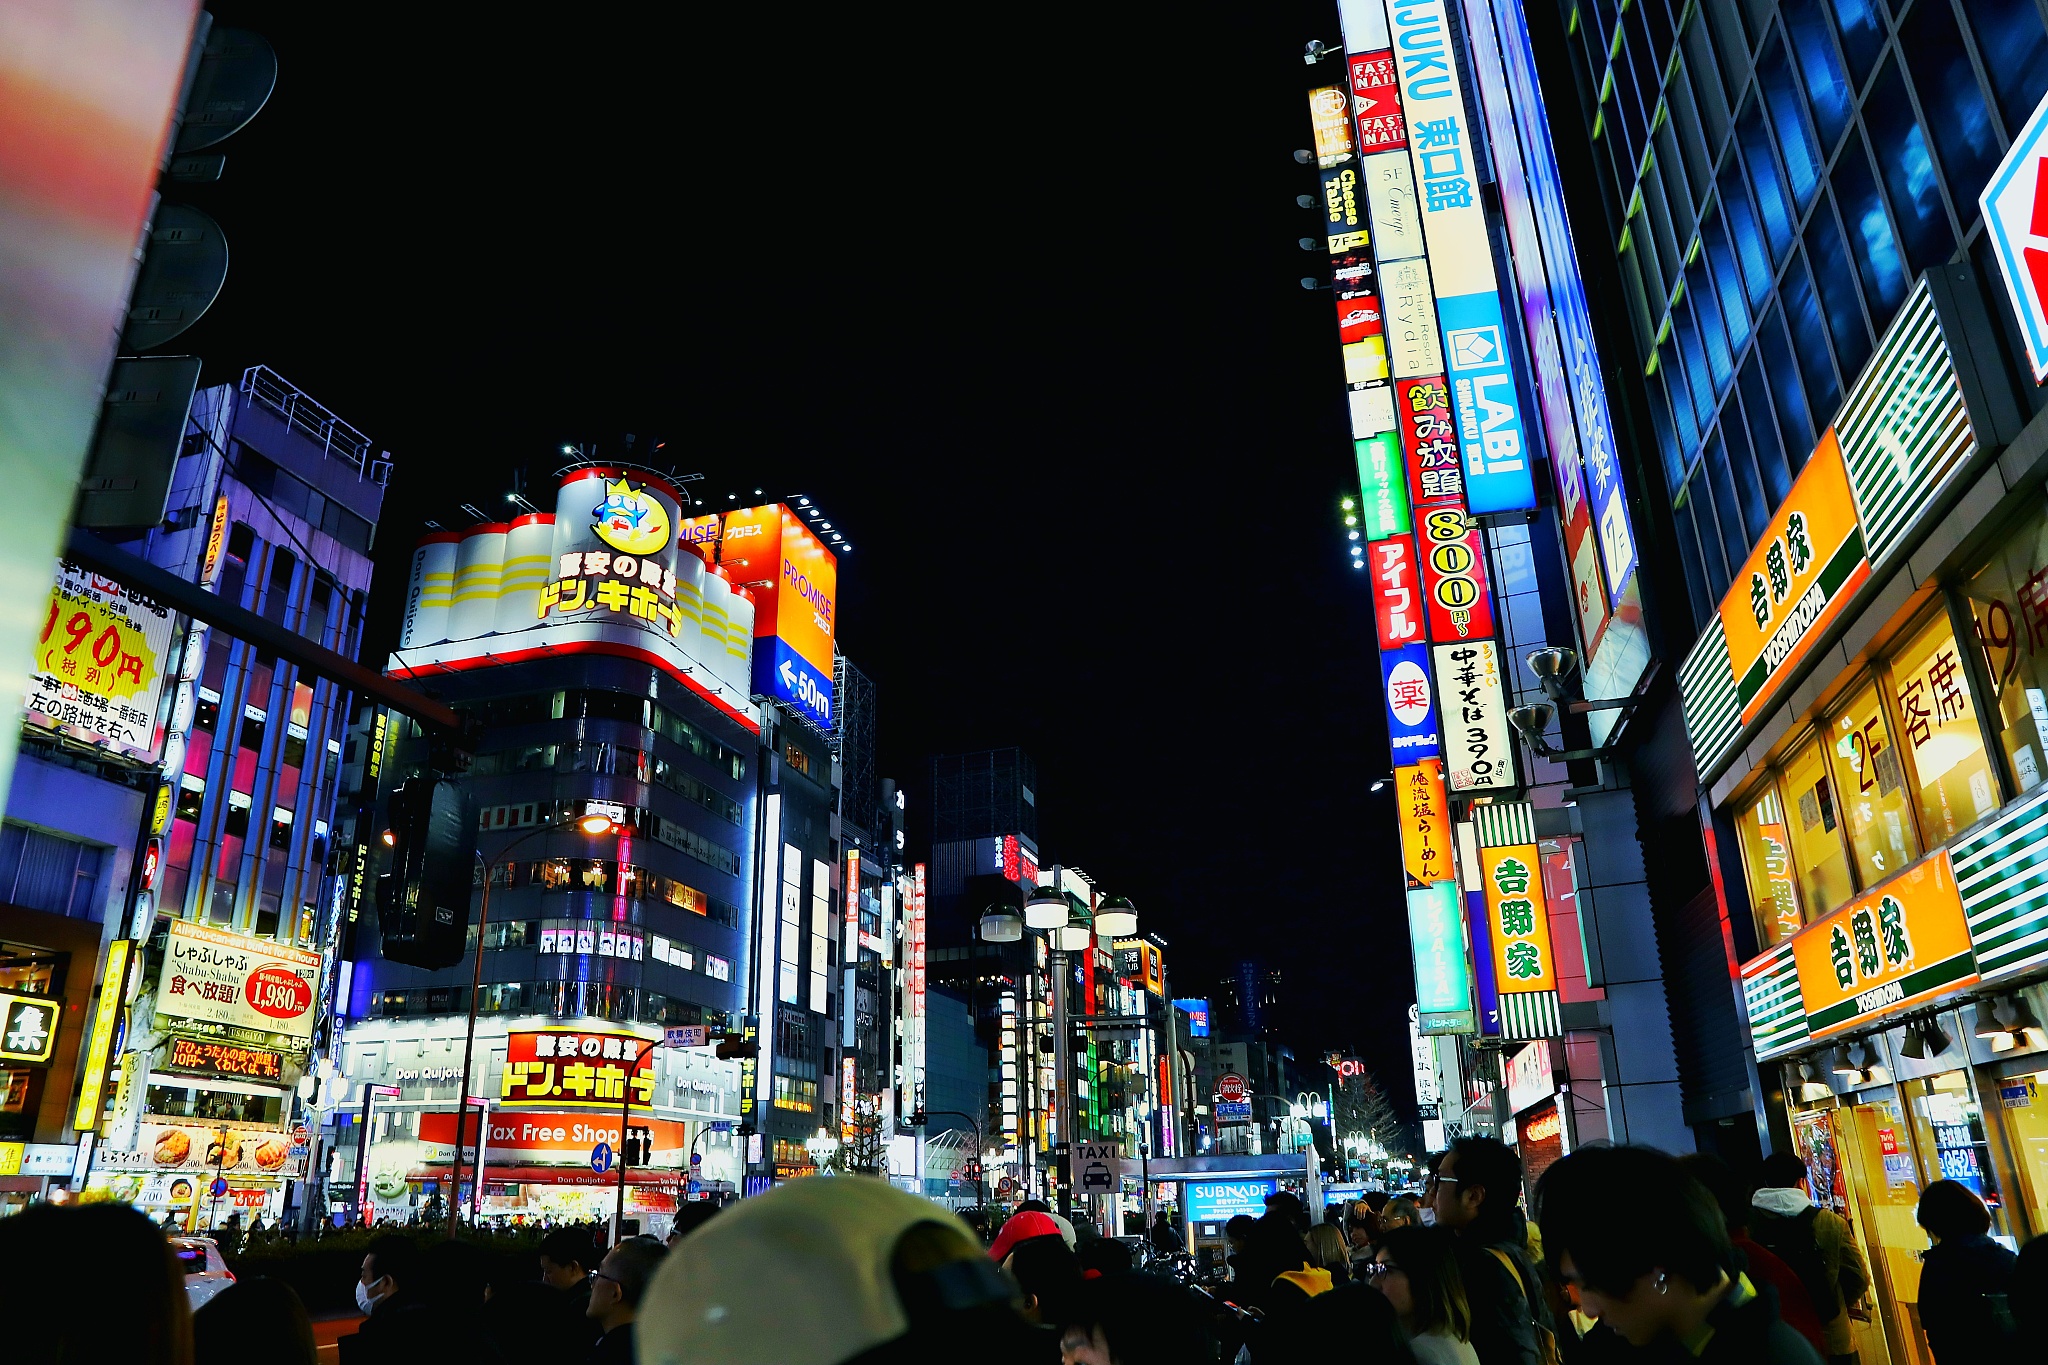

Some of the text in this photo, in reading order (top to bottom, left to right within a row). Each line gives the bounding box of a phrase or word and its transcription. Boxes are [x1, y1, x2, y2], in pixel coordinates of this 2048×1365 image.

[1383, 168, 1403, 182] 5F
[1414, 116, 1473, 212] 東口館
[1325, 178, 1342, 223] Table
[1340, 170, 1358, 226] Cheese
[1332, 236, 1349, 247] 7F
[1397, 295, 1420, 370] Rydia
[1415, 293, 1434, 368] Hair Resort
[1455, 378, 1480, 440] SHINJUKU
[1473, 374, 1524, 474] LABI
[1408, 385, 1462, 498] 飲み放題
[727, 523, 763, 540] プロミス
[783, 558, 832, 622] PROMISE
[1379, 543, 1416, 640] アイフル
[1751, 511, 1812, 632] 吉野家
[403, 550, 427, 647] Don Quijote
[39, 598, 144, 684] 190円
[813, 611, 831, 637] プロミス
[1762, 582, 1827, 675] YOSHINOYA
[1482, 643, 1498, 688] うまい
[29, 692, 136, 742] 左の路地を右へ
[109, 704, 149, 728] 一番街店
[798, 670, 830, 719] 50m
[1392, 679, 1428, 710] 薬
[1450, 647, 1493, 786] 中華そば390円
[1852, 716, 1882, 793] 2F
[1898, 649, 1965, 750] 客席
[1410, 770, 1440, 878] 俺流塩らーめん
[1496, 858, 1541, 979] 吉野家
[174, 941, 249, 971] しゃぶしゃぶ
[274, 945, 287, 958] for
[295, 952, 319, 966] hours
[1831, 897, 1911, 991] 吉野家
[252, 981, 296, 1011] 1,980
[1856, 981, 1904, 1013] YOSHINOYA
[7, 1005, 48, 1051] 集
[230, 1028, 265, 1042] USAGIYA
[536, 1034, 639, 1061] 驚安の殿堂
[667, 1028, 702, 1039] 歌舞伎町
[395, 1066, 419, 1081] Don
[677, 1076, 691, 1089] Don
[1221, 1083, 1244, 1095] 消火栓
[522, 1123, 566, 1142] Free
[572, 1123, 620, 1145] Shop
[1076, 1145, 1116, 1159] TAXI
[557, 1176, 606, 1185] Don Quijote
[1195, 1184, 1269, 1199] SUBNADE
